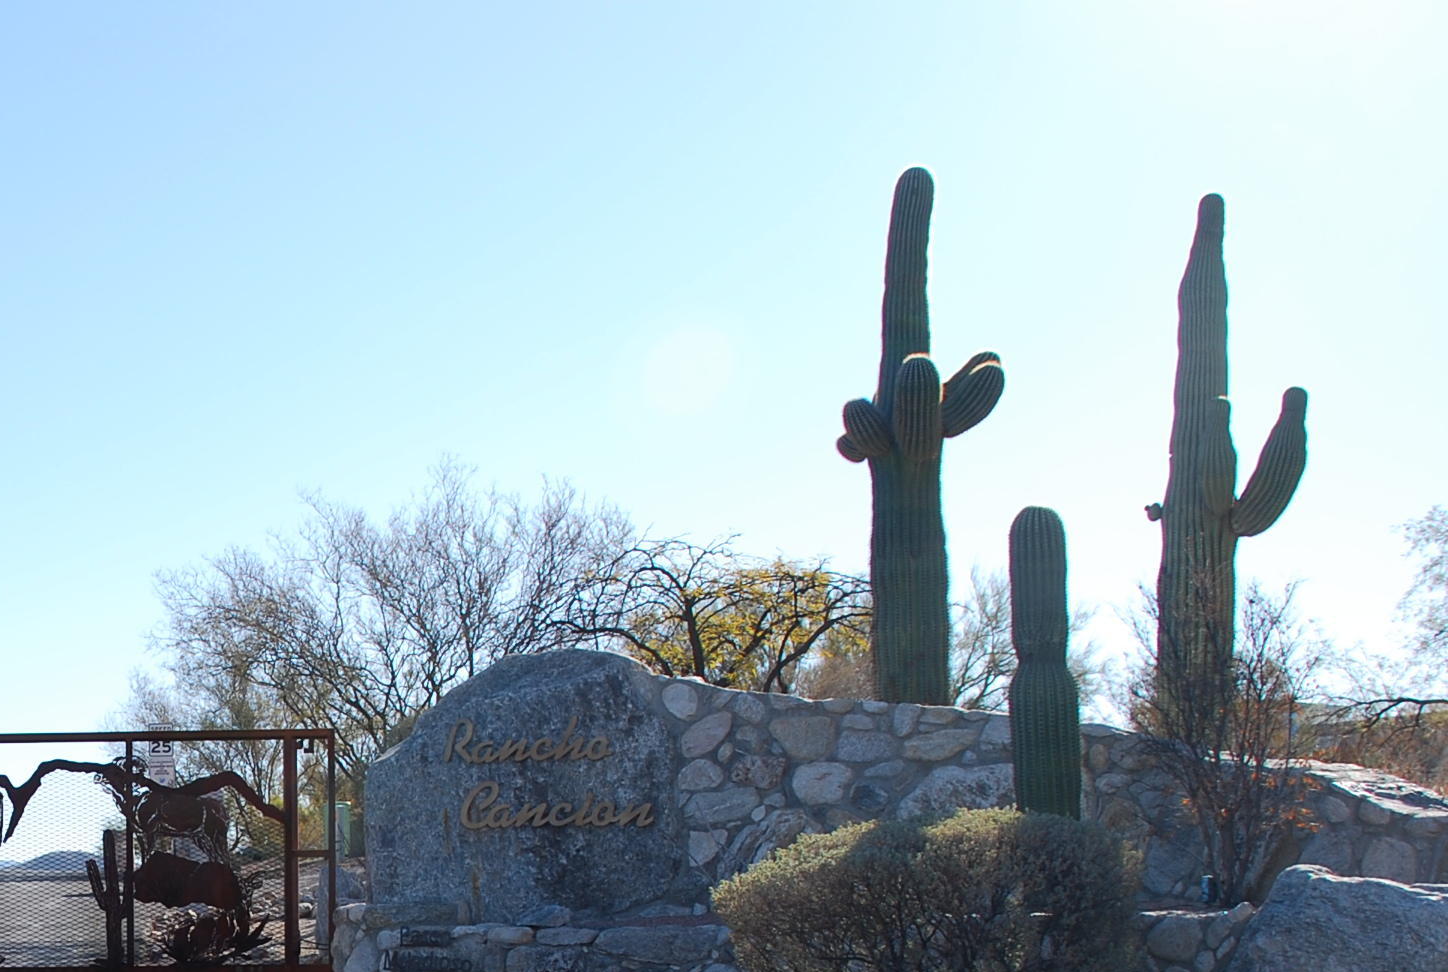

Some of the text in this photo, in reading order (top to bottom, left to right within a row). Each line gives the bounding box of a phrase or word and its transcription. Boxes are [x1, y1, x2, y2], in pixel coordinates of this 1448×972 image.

[152, 740, 171, 753] 25
[445, 715, 612, 764] Rancho
[460, 781, 654, 830] Cancion
